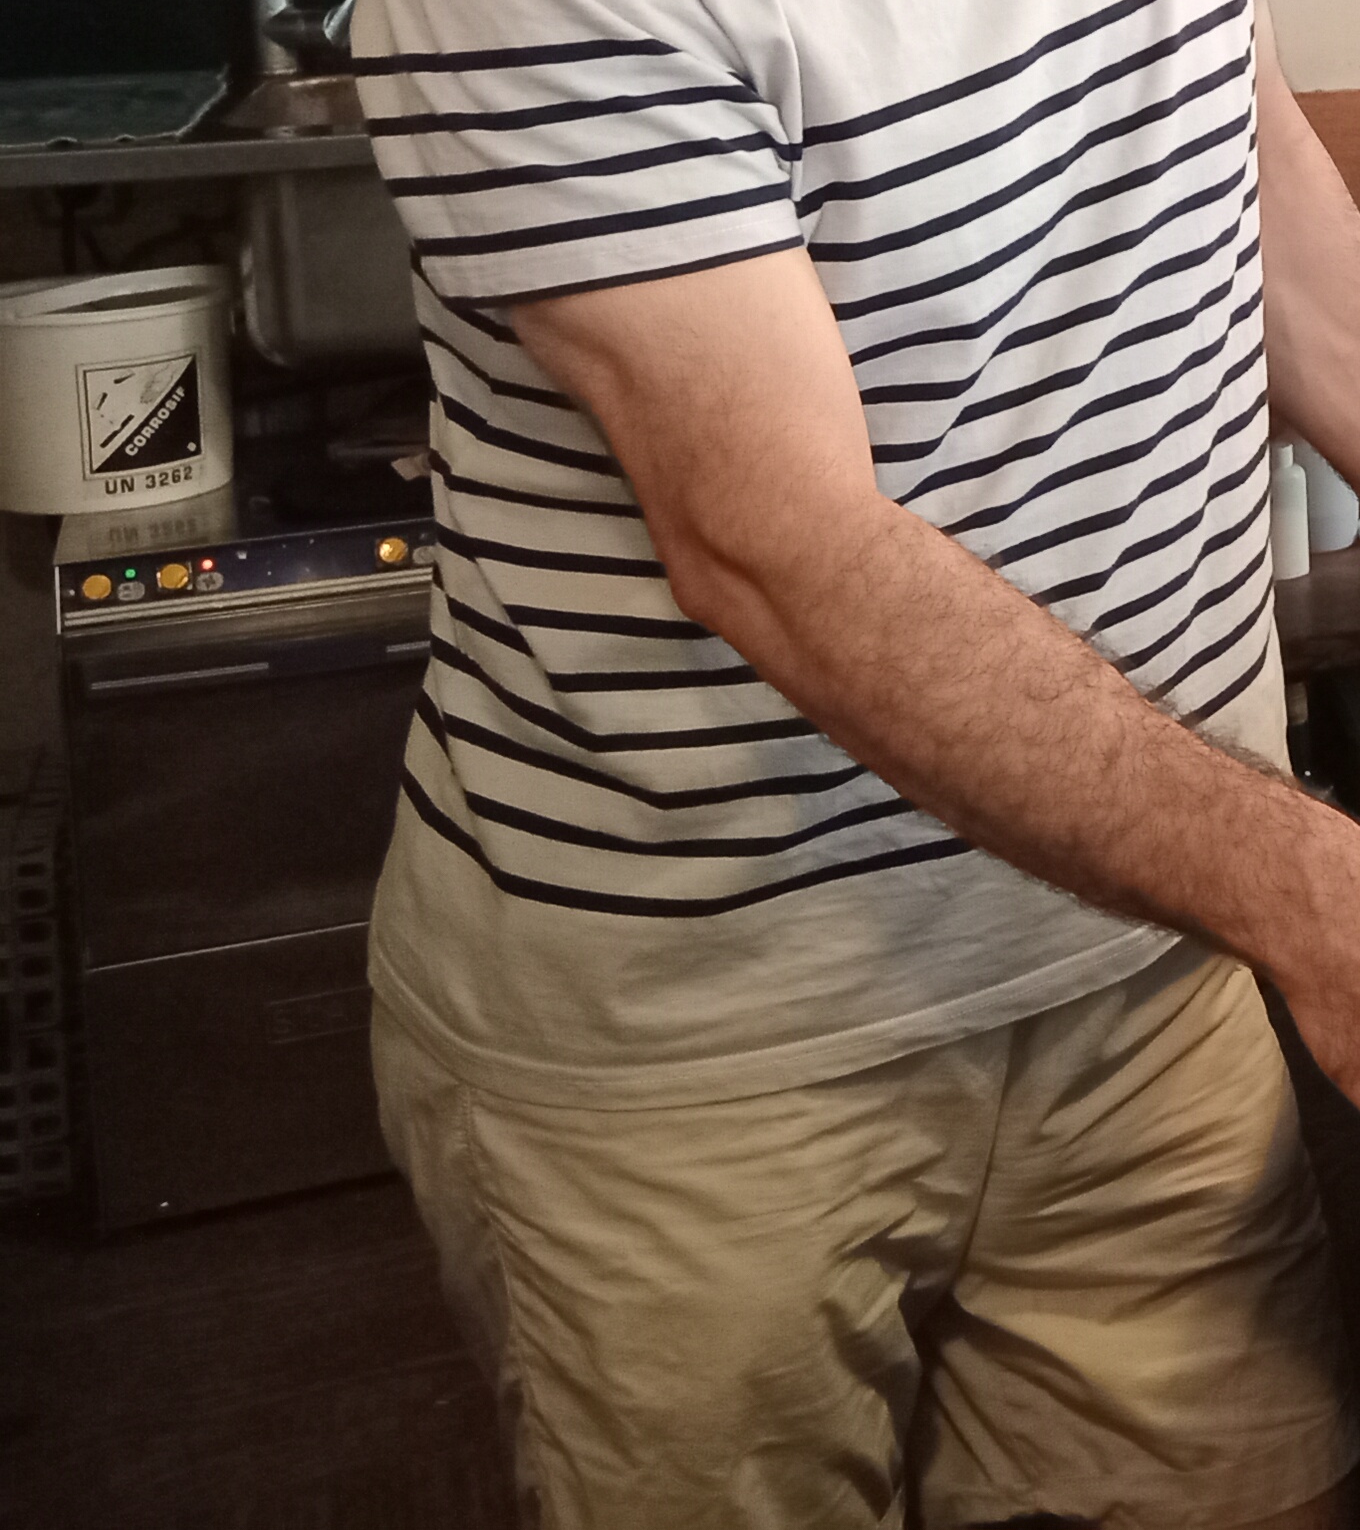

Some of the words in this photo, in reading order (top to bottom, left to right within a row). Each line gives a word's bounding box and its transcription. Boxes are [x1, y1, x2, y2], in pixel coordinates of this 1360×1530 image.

[124, 385, 186, 457] CORROSIF
[104, 476, 136, 495] UN
[145, 465, 193, 490] 3262
